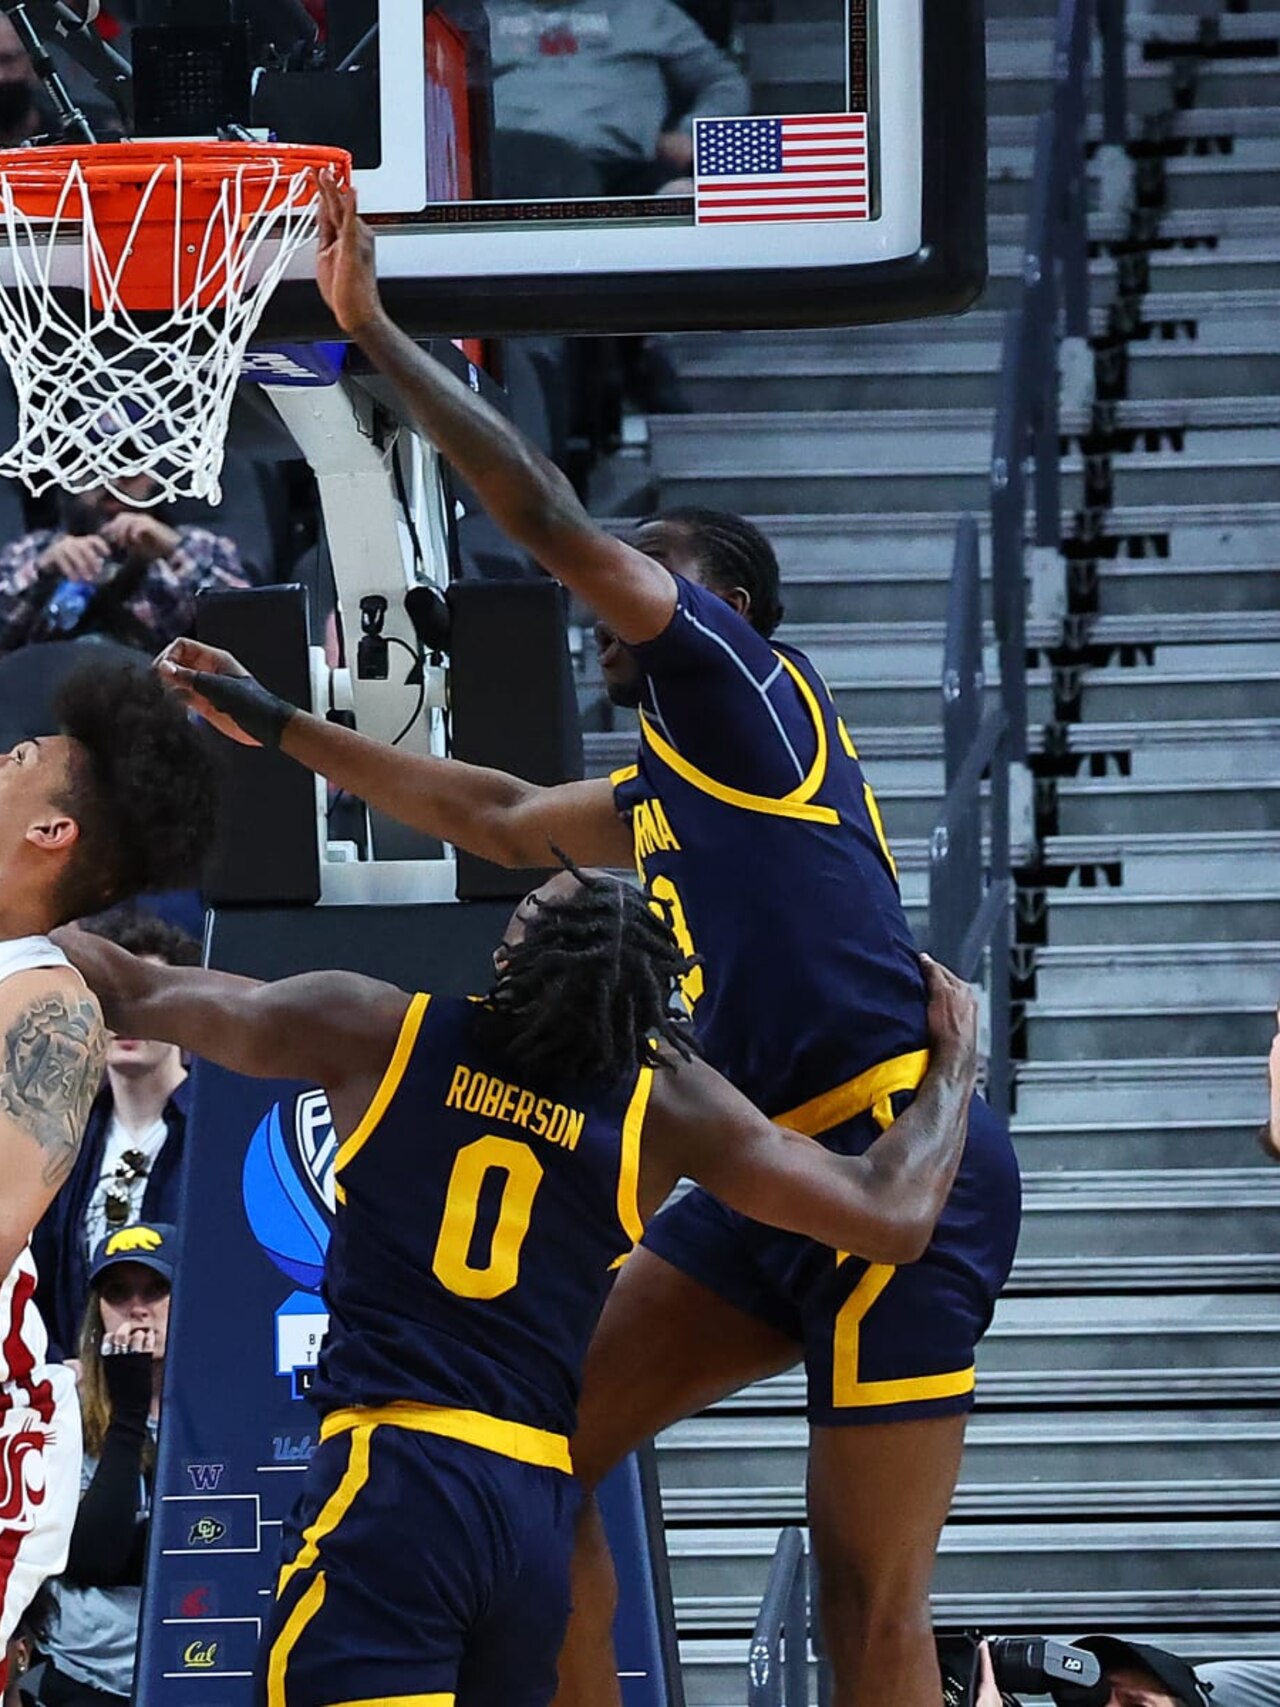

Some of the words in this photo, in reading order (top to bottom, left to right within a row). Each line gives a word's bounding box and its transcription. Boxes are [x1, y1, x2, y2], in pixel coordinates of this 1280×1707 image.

[445, 1065, 585, 1151] ROBERSON
[432, 1134, 544, 1299] 0
[187, 1464, 224, 1490] W
[184, 1640, 218, 1664] Cal
